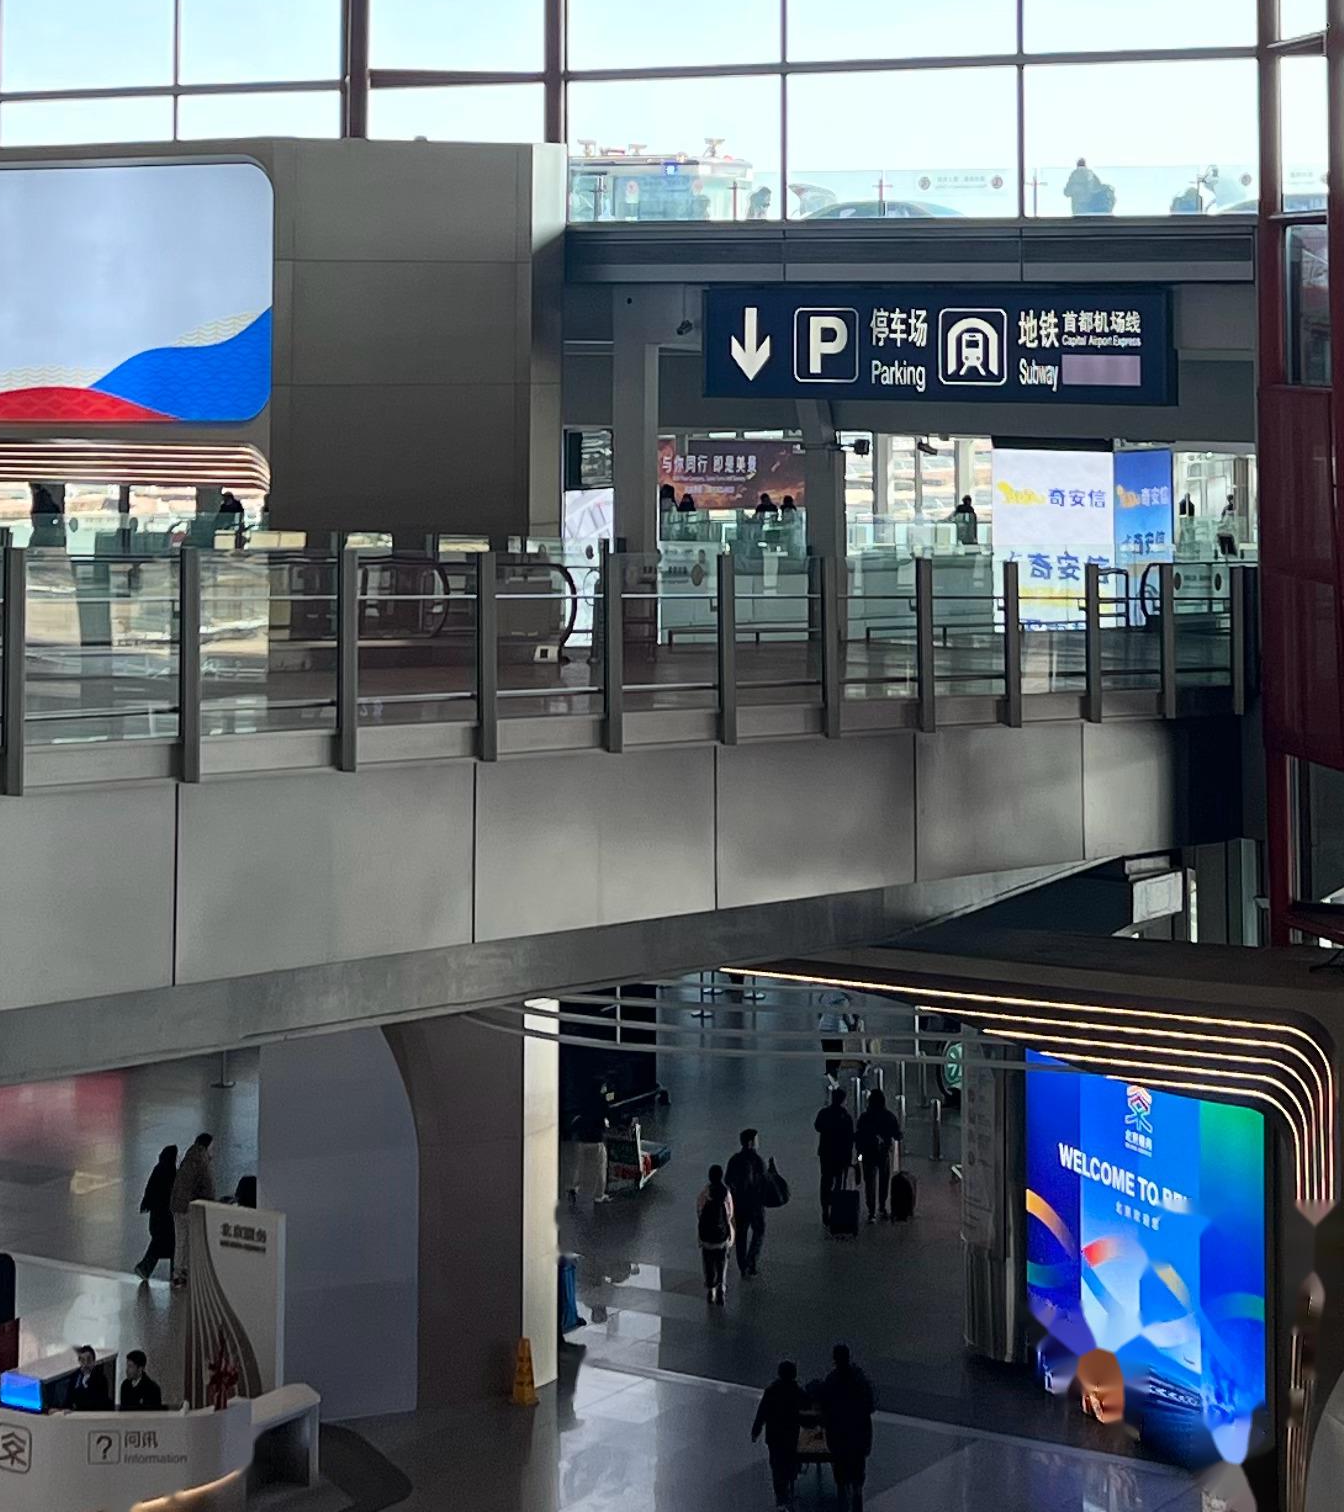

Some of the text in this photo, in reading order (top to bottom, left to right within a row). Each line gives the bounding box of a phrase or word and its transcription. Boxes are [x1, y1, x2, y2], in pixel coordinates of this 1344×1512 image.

[869, 308, 928, 349] 停车场
[1018, 309, 1059, 348] 地铁
[1062, 311, 1141, 333] 首都机场线
[1062, 335, 1141, 348] Capital Airport Express
[871, 358, 926, 393] Parking
[1019, 358, 1058, 392] Subway
[1049, 488, 1105, 508] 奇安信
[1058, 1142, 1135, 1197] WELCOME
[1137, 1176, 1159, 1206] TO
[125, 1431, 158, 1448] 问讯
[124, 1454, 188, 1464] Information
